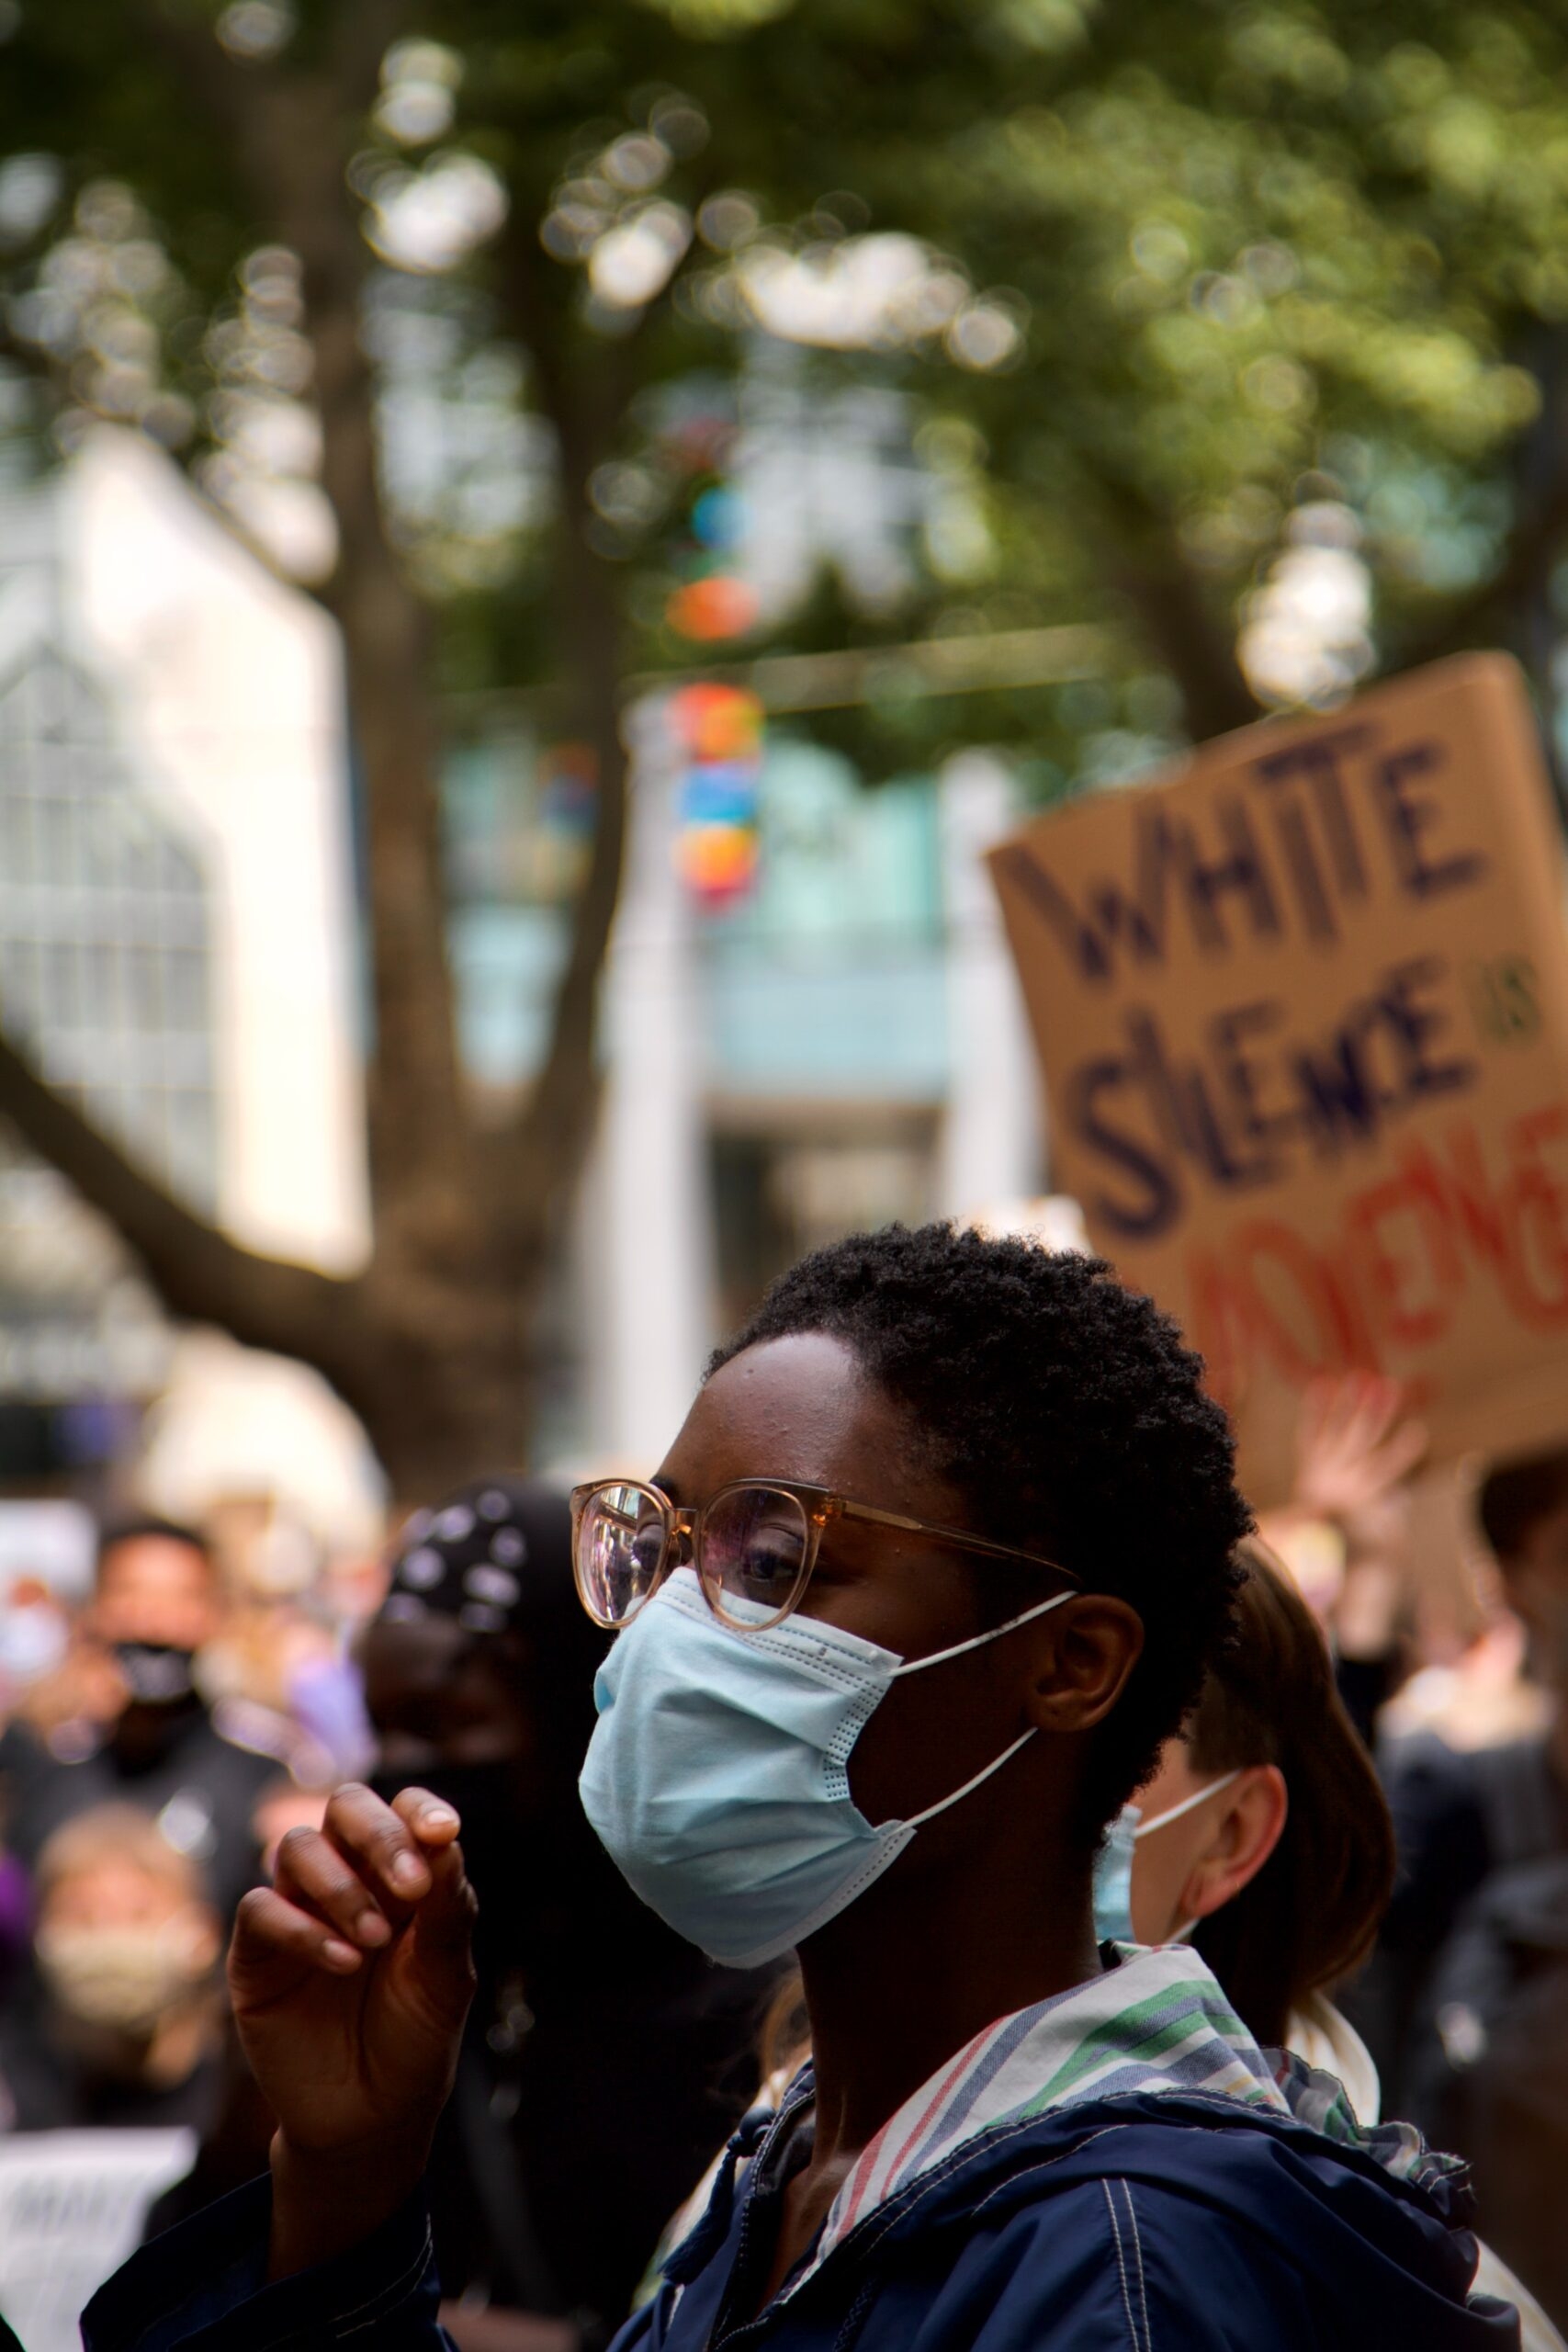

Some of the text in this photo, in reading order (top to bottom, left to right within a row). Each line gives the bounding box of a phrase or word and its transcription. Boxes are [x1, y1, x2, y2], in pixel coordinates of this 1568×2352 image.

[1005, 724, 1484, 987] WHITE
[1066, 952, 1543, 1242] SILENCE IS
